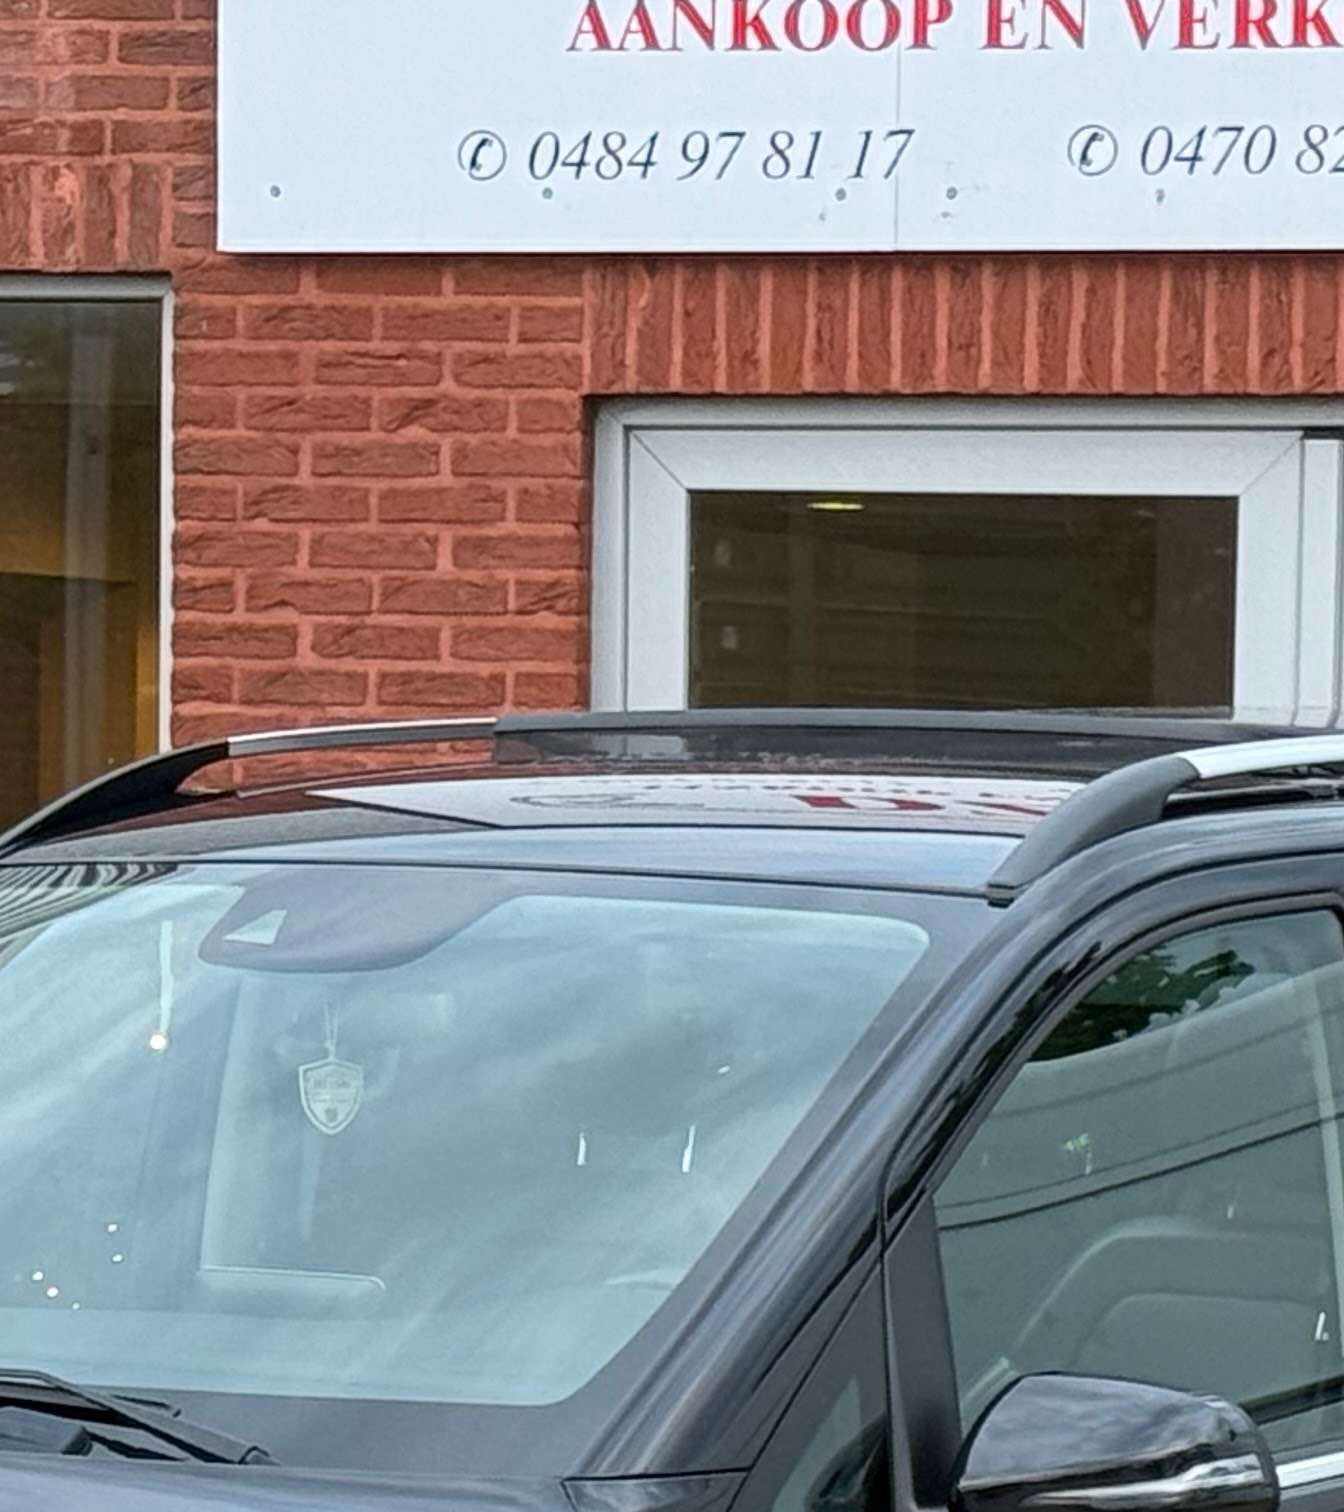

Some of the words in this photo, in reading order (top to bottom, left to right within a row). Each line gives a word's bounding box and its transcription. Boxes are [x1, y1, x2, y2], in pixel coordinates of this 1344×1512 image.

[565, 0, 954, 53] AANKOOP
[979, 0, 1087, 51] EN
[528, 130, 659, 180] 0484
[676, 130, 747, 180] 97
[761, 130, 824, 179] 81
[847, 129, 916, 179] 17
[1140, 124, 1276, 175] 0470
